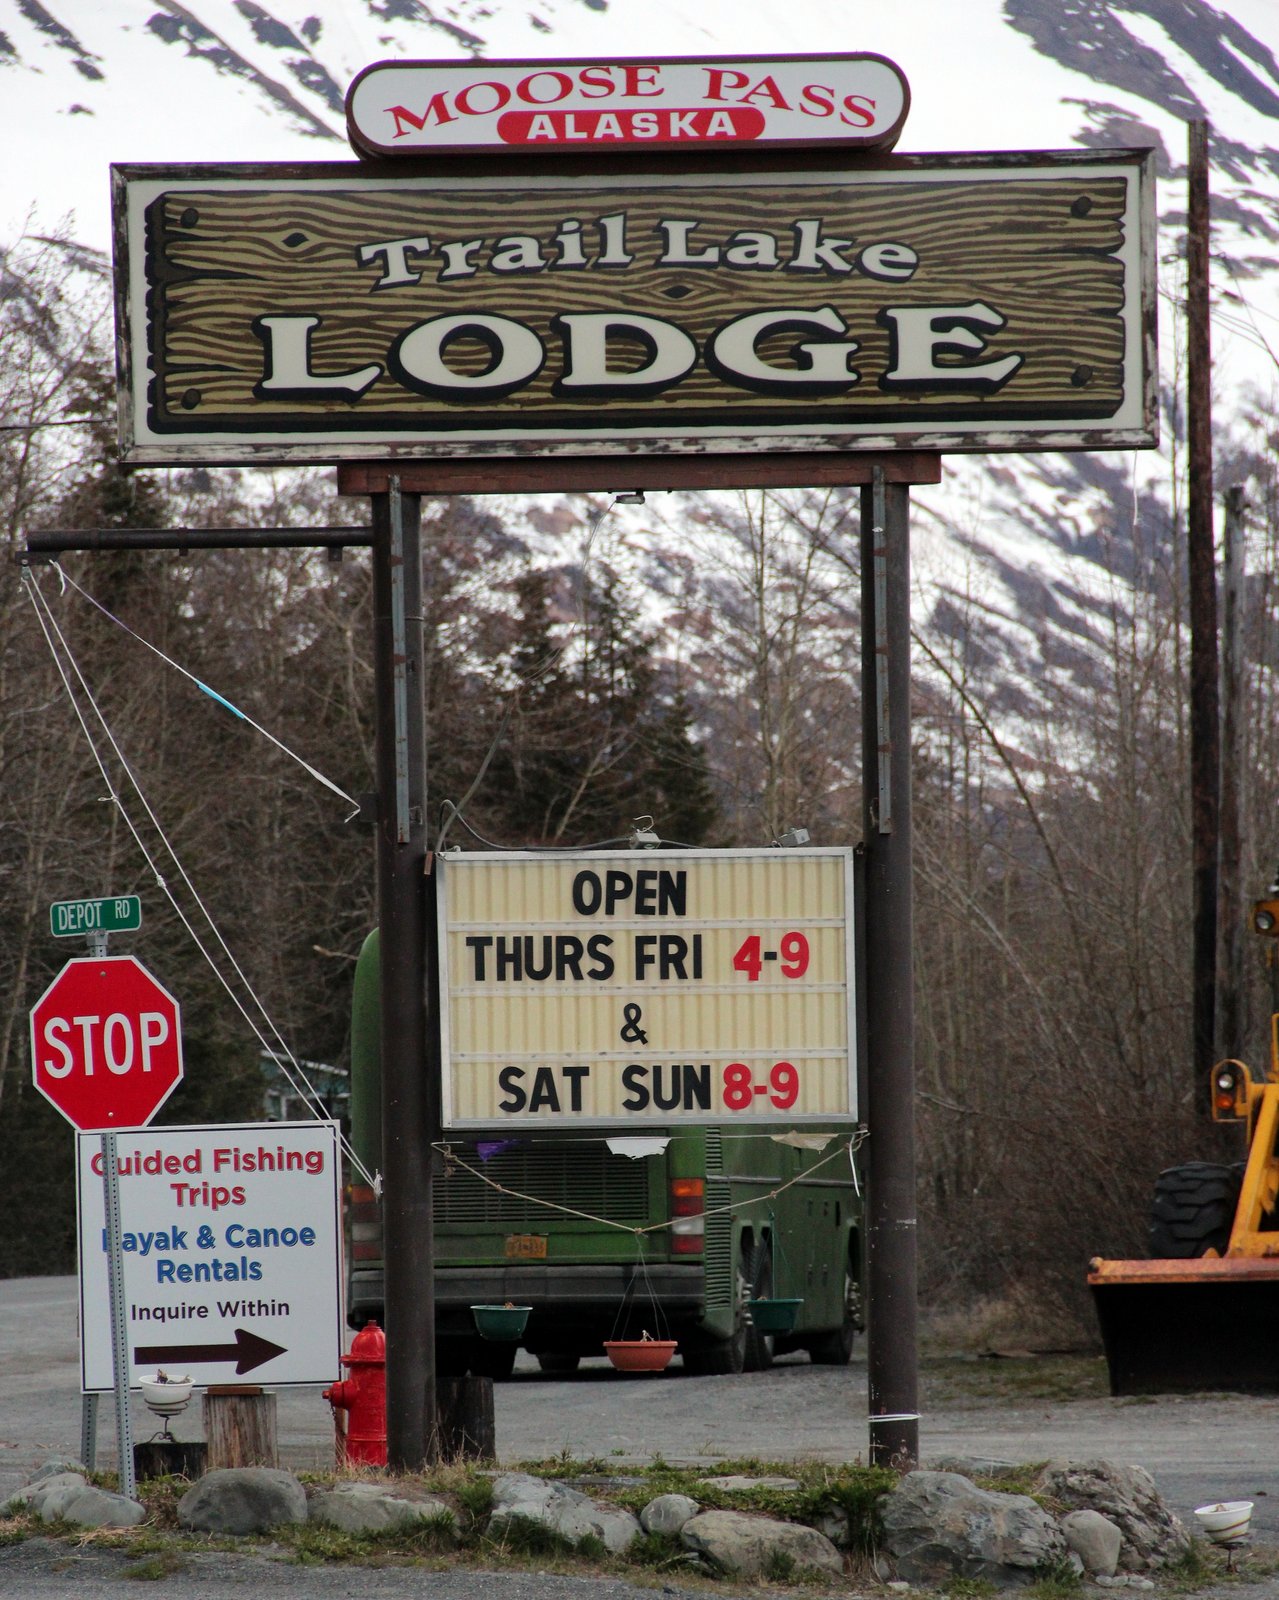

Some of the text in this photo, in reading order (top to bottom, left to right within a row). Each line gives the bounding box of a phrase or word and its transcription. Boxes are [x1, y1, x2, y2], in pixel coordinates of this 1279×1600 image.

[383, 65, 877, 139] MOOSE PASS
[526, 110, 737, 139] ALASKA
[359, 214, 919, 289] Trail Lake
[256, 302, 1025, 393] LODGE
[572, 870, 687, 916] OPEN
[58, 900, 130, 930] DEPOT RD
[466, 931, 810, 981] THURS FRI 4-9
[620, 1002, 649, 1045] &
[44, 1012, 169, 1079] STOP
[498, 1062, 800, 1113] SAT SUN 8-9
[213, 1146, 324, 1175] Fishing
[170, 1181, 247, 1211] Trips
[196, 1225, 216, 1250] &
[225, 1224, 317, 1249] Canoe
[157, 1256, 263, 1284] Rentals
[131, 1299, 290, 1323] Inquire Within
